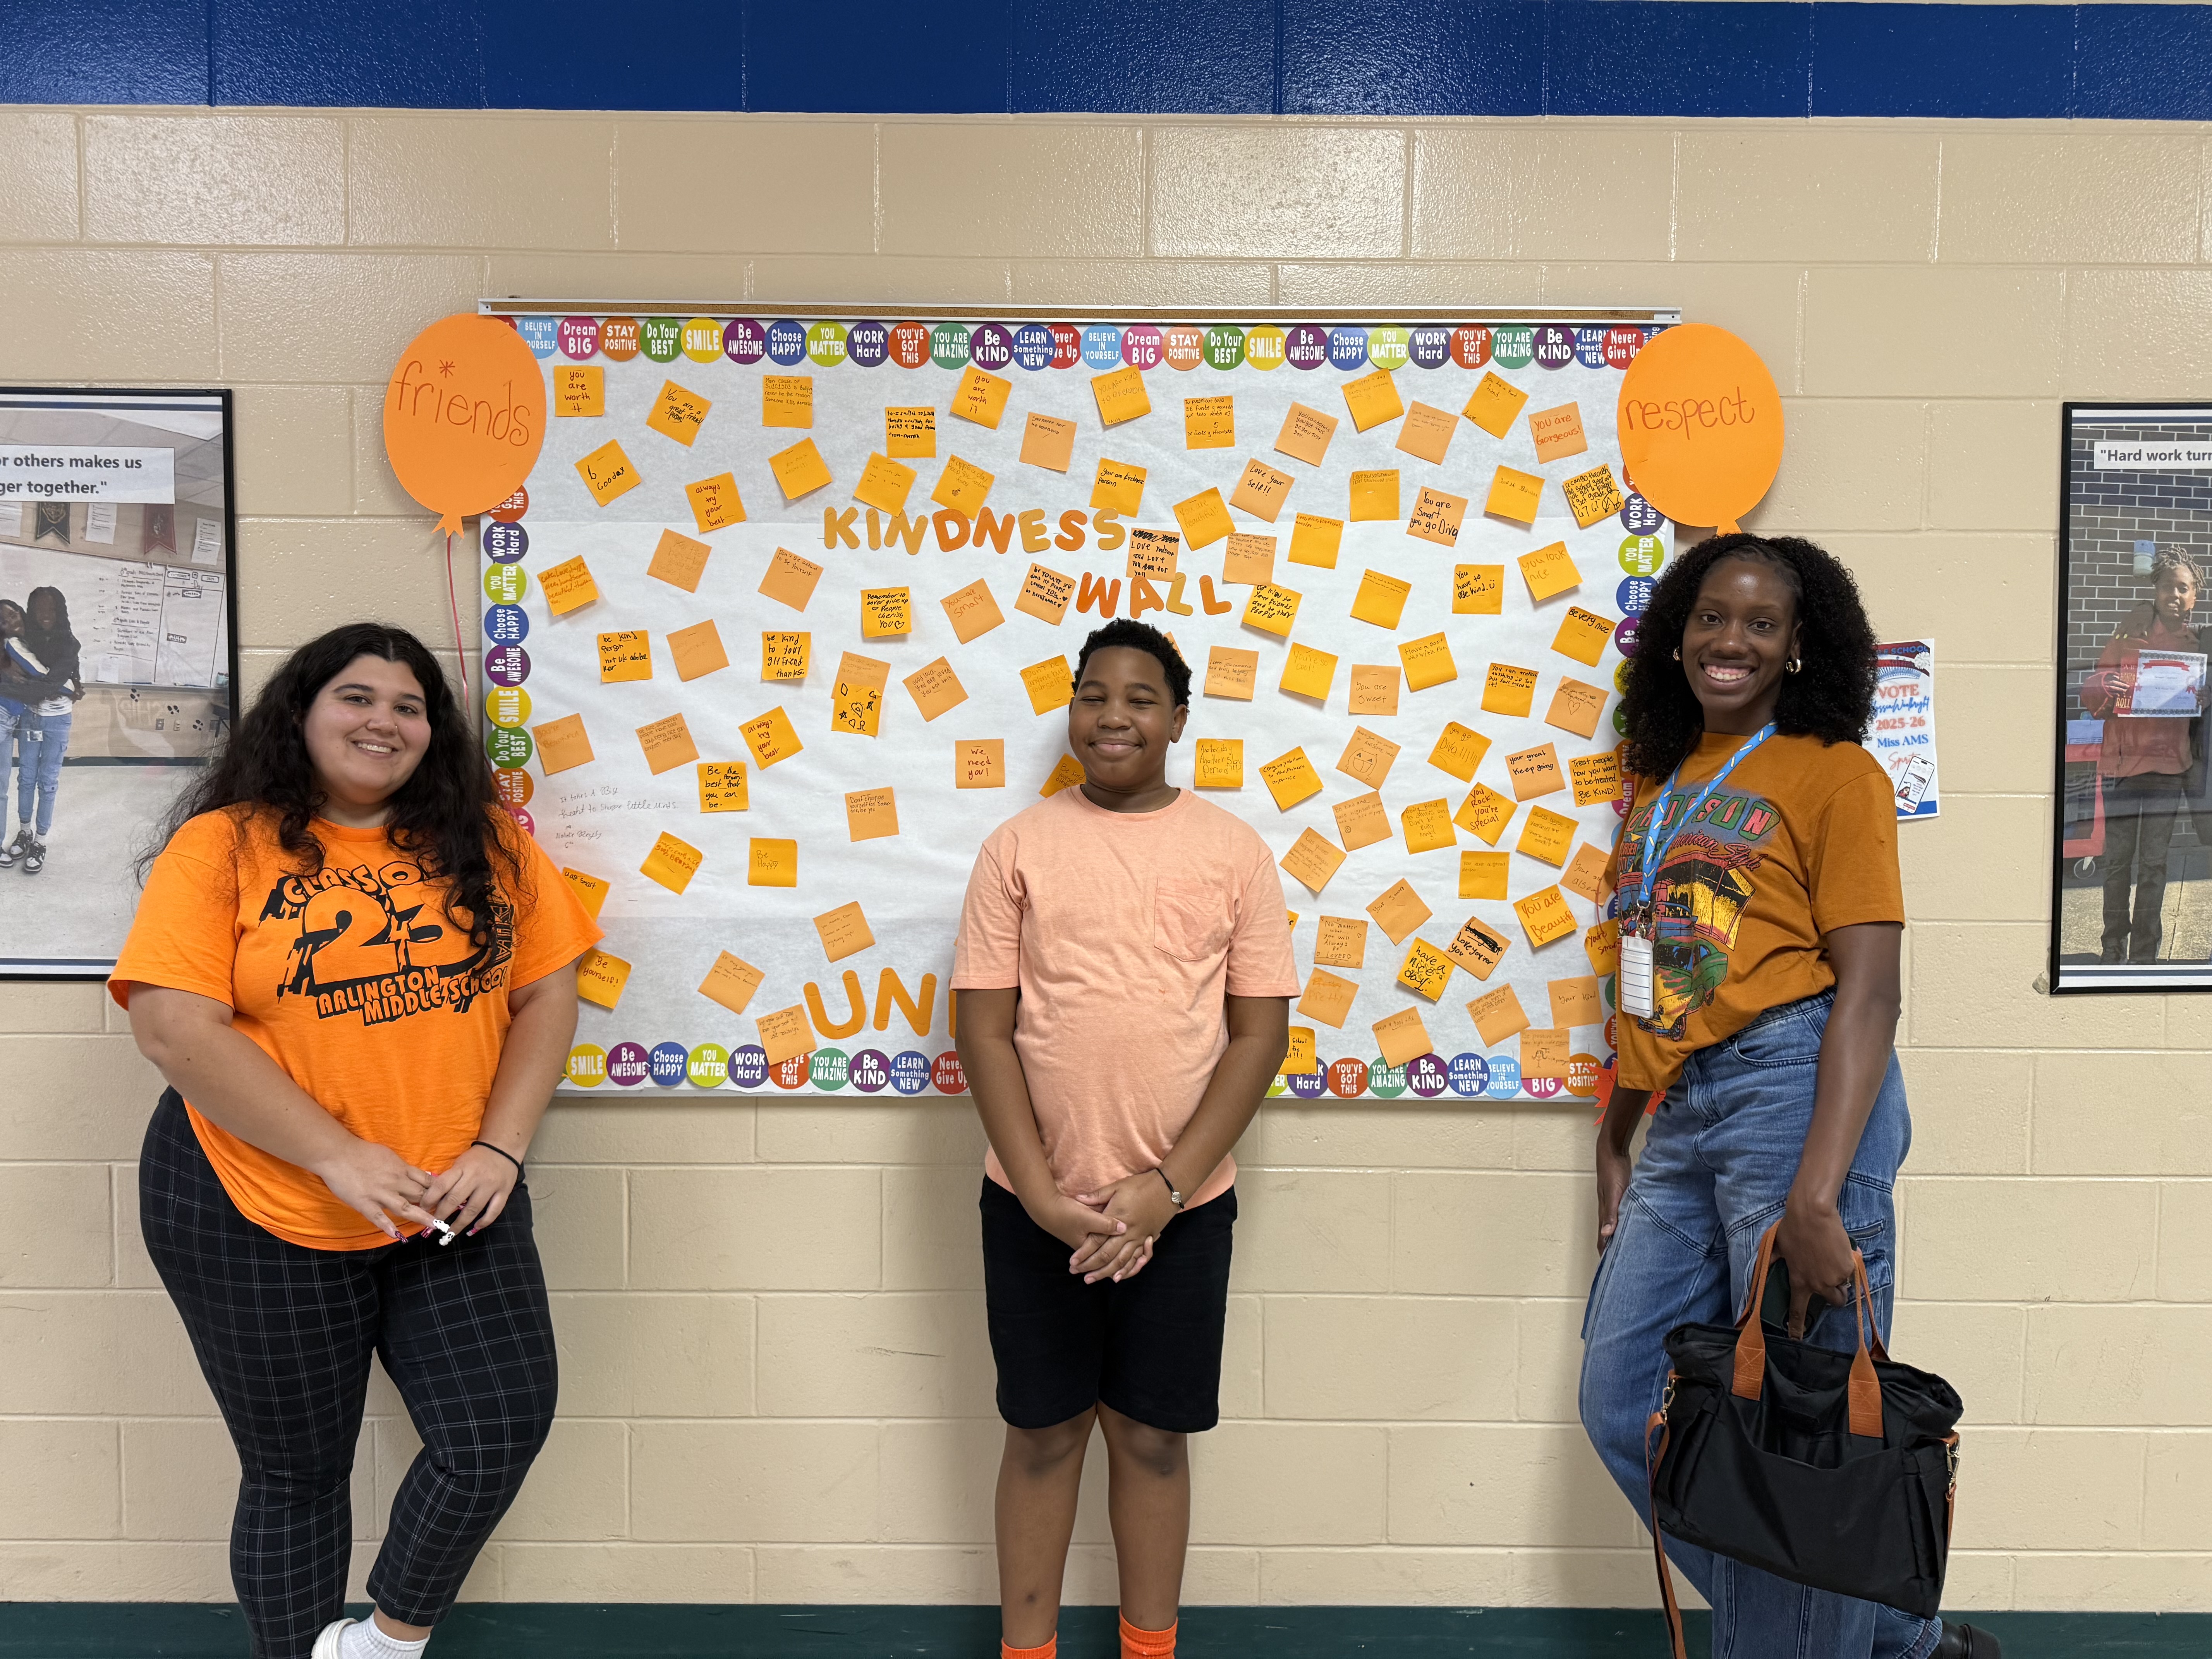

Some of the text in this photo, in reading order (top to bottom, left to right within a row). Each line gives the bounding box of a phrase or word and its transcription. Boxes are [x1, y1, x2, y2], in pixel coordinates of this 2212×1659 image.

[525, 322, 551, 331] BELIEVE
[564, 322, 596, 336] Dream
[607, 326, 635, 337] STAY
[647, 325, 678, 339] Do Your
[738, 324, 752, 337] Be
[821, 328, 834, 339] YOU
[896, 328, 924, 339] YOU'VE
[535, 331, 541, 340] IN
[686, 330, 719, 350] SMILE
[771, 329, 802, 342] Choose
[854, 330, 884, 343] WORK
[934, 332, 967, 343] YOU ARE
[985, 329, 1000, 344] Be
[1019, 331, 1046, 344] LEARN
[1611, 331, 1636, 344] Never
[525, 340, 555, 349] OURSELF
[568, 340, 592, 353] BIG
[605, 338, 636, 350] POSITIVE
[651, 340, 673, 356] BEST
[728, 341, 763, 355] AWESOME
[771, 342, 801, 356] HAPPY
[810, 340, 845, 356] MATTER
[857, 344, 881, 358] Hard
[902, 341, 919, 351] GOT
[1013, 345, 1053, 356] Something
[902, 352, 919, 363] THIS
[934, 345, 969, 358] AMAZING
[976, 346, 1008, 361] KIND
[1607, 346, 1627, 359] Give
[1023, 355, 1044, 366] NEW
[395, 359, 530, 446] friends
[1626, 386, 1754, 440] respect
[14, 453, 64, 467] others
[69, 455, 120, 469] makes
[125, 459, 142, 469] us
[2101, 449, 2142, 461] "Hard
[2147, 449, 2182, 461] work
[27, 480, 107, 496] together."
[824, 506, 1125, 555] KINDNESS
[1638, 538, 1654, 572] MATTER
[490, 575, 501, 590] YOU
[503, 566, 517, 600] MATTER
[1076, 572, 1232, 618] WALL
[494, 609, 505, 639] Choose
[507, 610, 520, 639] HAPPY
[1891, 645, 1928, 654] SCHOOL
[1878, 684, 1919, 699] VOTE
[499, 690, 519, 722] SMILE
[2116, 697, 2130, 708] ROLL
[1875, 716, 1925, 730] 2025-26
[1878, 734, 1929, 748] Miss AMS
[1572, 756, 1614, 768] Treat people
[968, 767, 988, 779] you!
[513, 771, 524, 802] POSITIVE
[1708, 843, 1768, 871] Style
[283, 864, 383, 907] CLASS
[318, 966, 440, 1019] ARLINGTON
[364, 986, 442, 1026] MIDDLE
[570, 1056, 603, 1076] SMILE
[896, 1056, 924, 1068] LEARN
[1420, 1060, 1435, 1073] Be
[890, 1068, 929, 1079] Something
[900, 1078, 921, 1091] NEW
[1412, 1074, 1444, 1089] KIND
[1532, 1078, 1554, 1092] BIG
